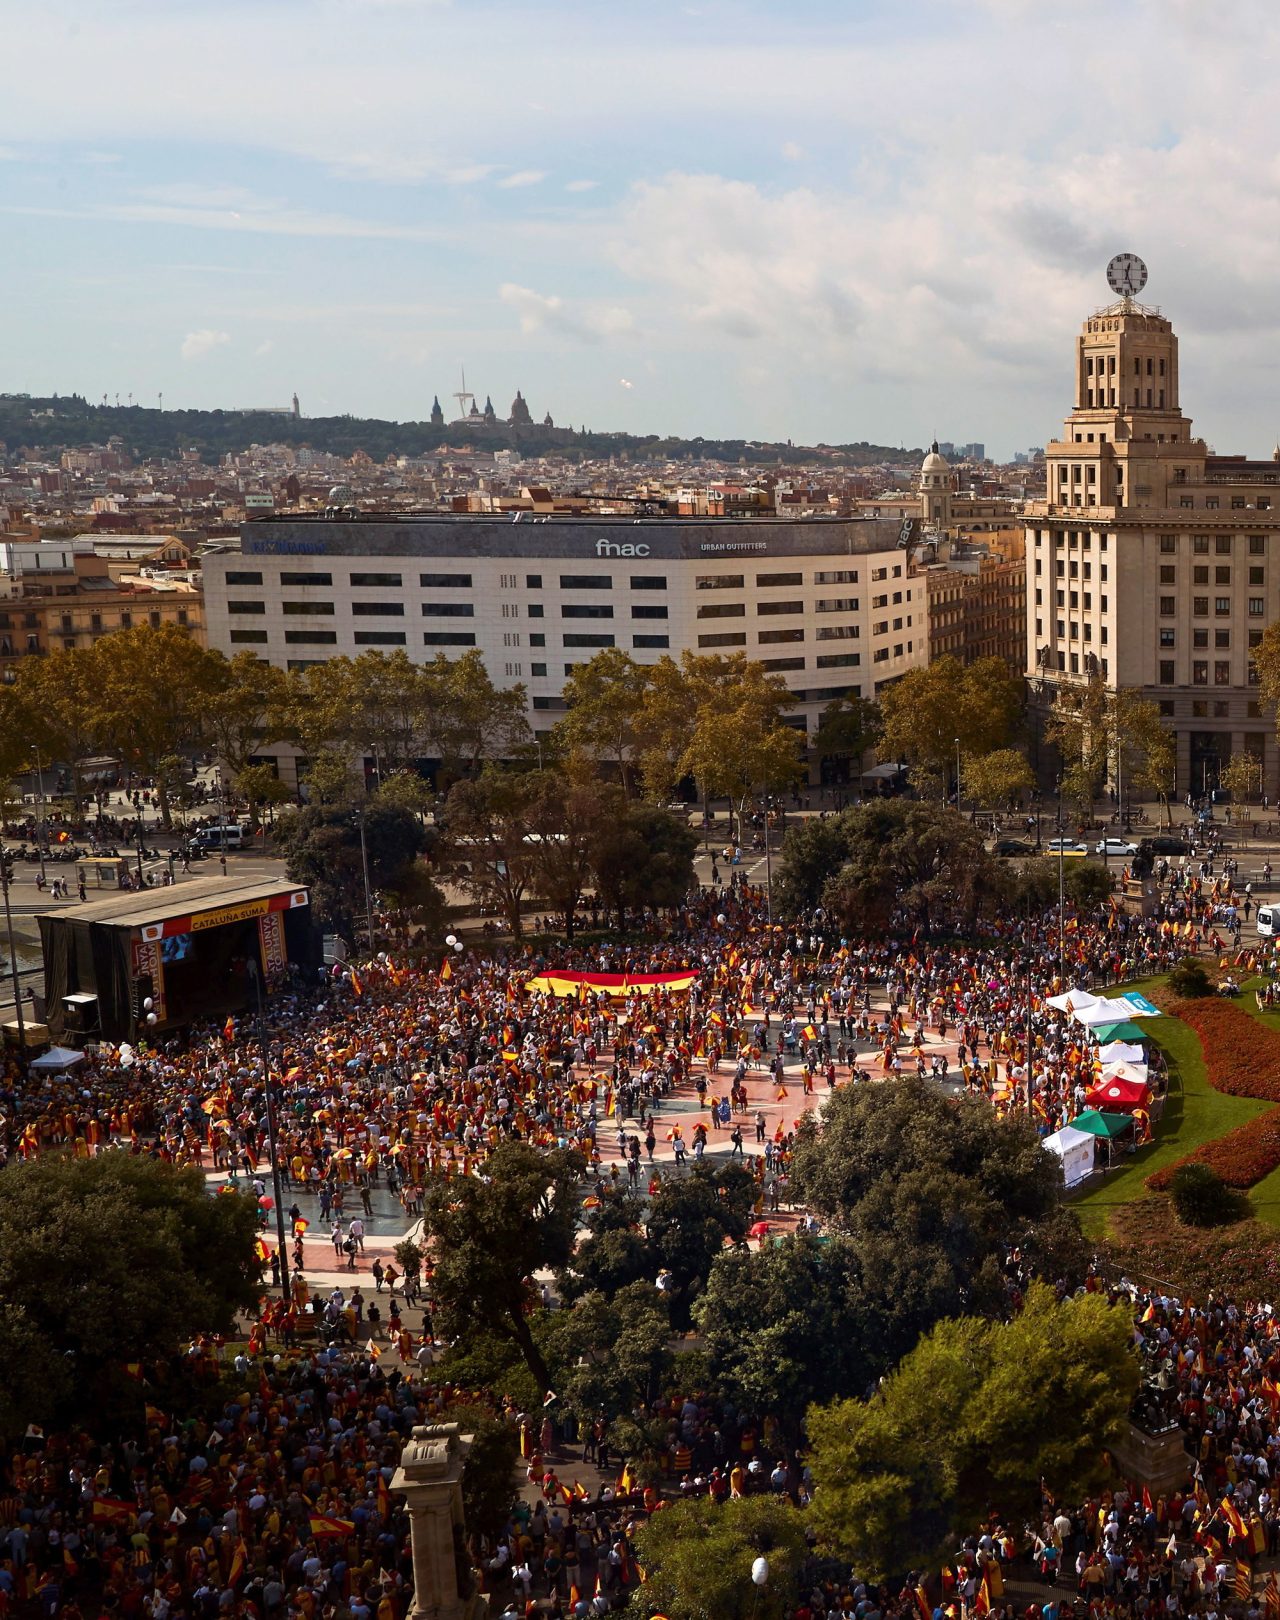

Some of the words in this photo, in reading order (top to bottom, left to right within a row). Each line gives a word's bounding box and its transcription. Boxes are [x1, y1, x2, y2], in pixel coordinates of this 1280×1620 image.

[895, 518, 914, 550] nac
[595, 538, 650, 557] fnac
[701, 543, 725, 551] URBAN
[726, 542, 767, 550] OUTFITTERS
[192, 911, 239, 930] CATALUÑA
[240, 907, 265, 918] SUMA
